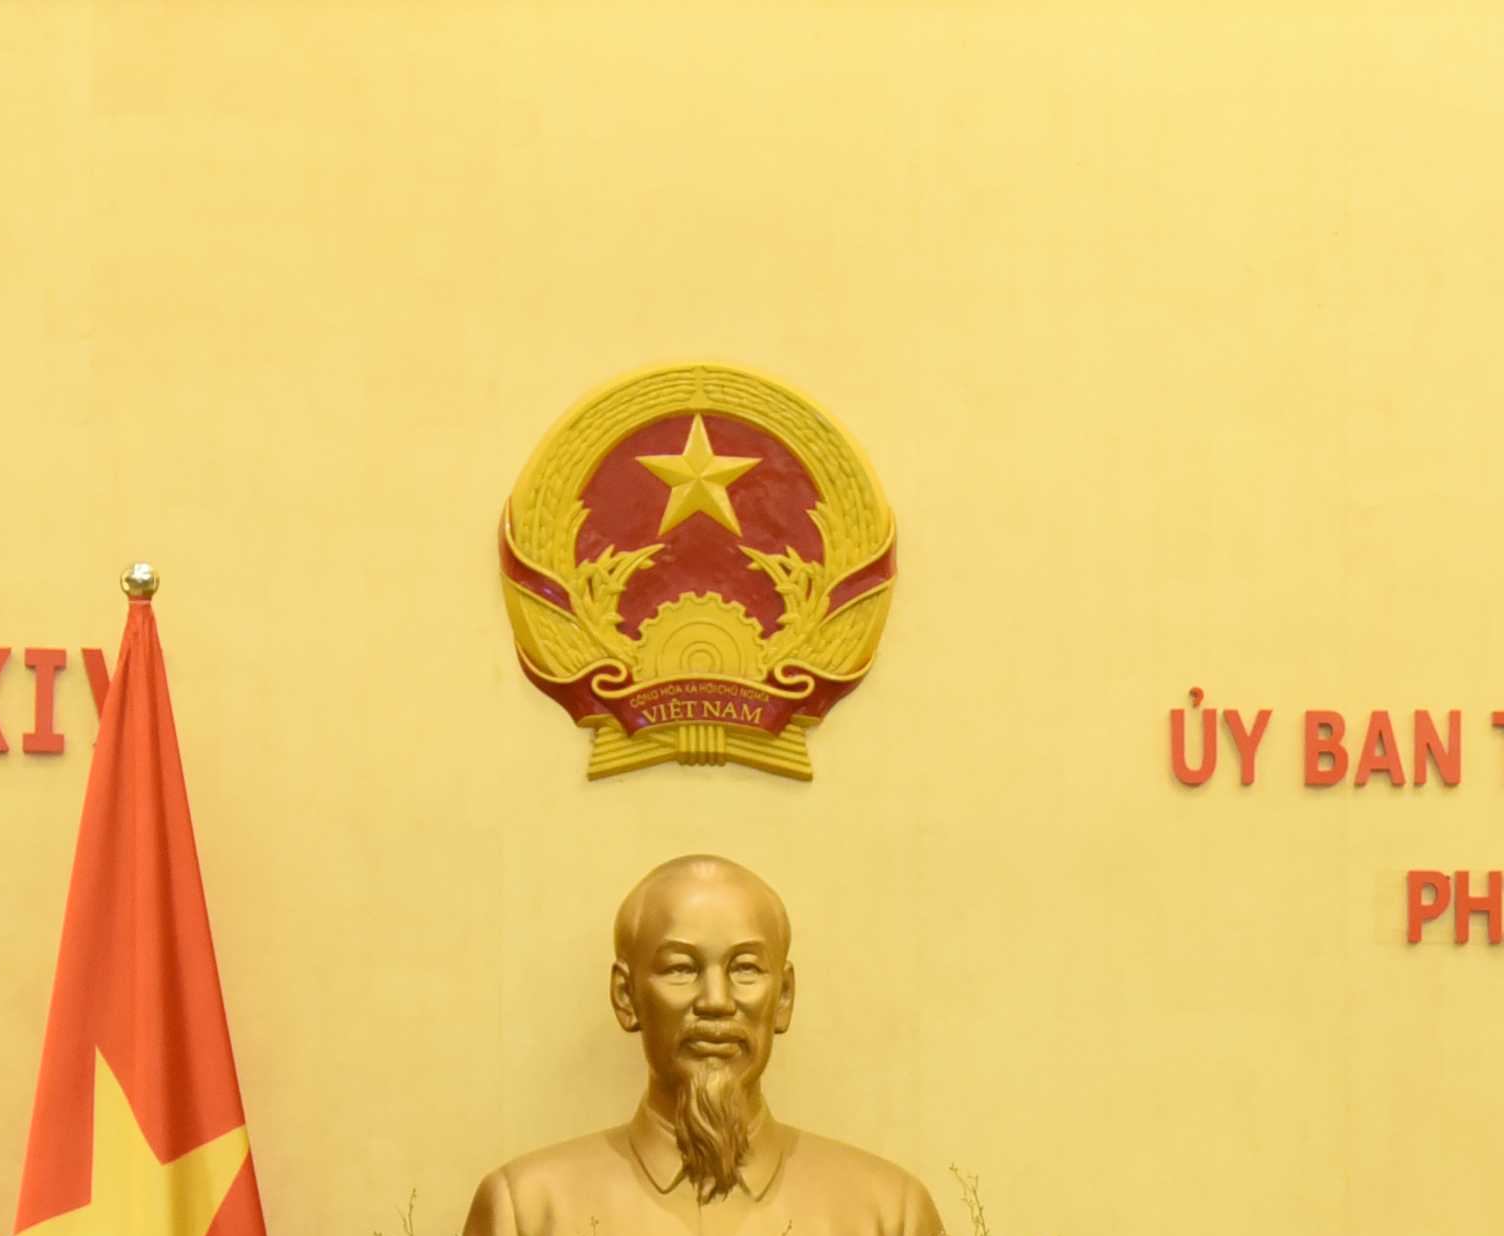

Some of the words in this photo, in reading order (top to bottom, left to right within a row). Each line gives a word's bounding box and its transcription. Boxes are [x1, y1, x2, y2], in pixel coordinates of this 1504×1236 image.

[642, 698, 697, 723] VIỆT
[702, 700, 763, 724] NAM
[1171, 687, 1273, 786] ỦY
[1304, 709, 1462, 786] BAN
